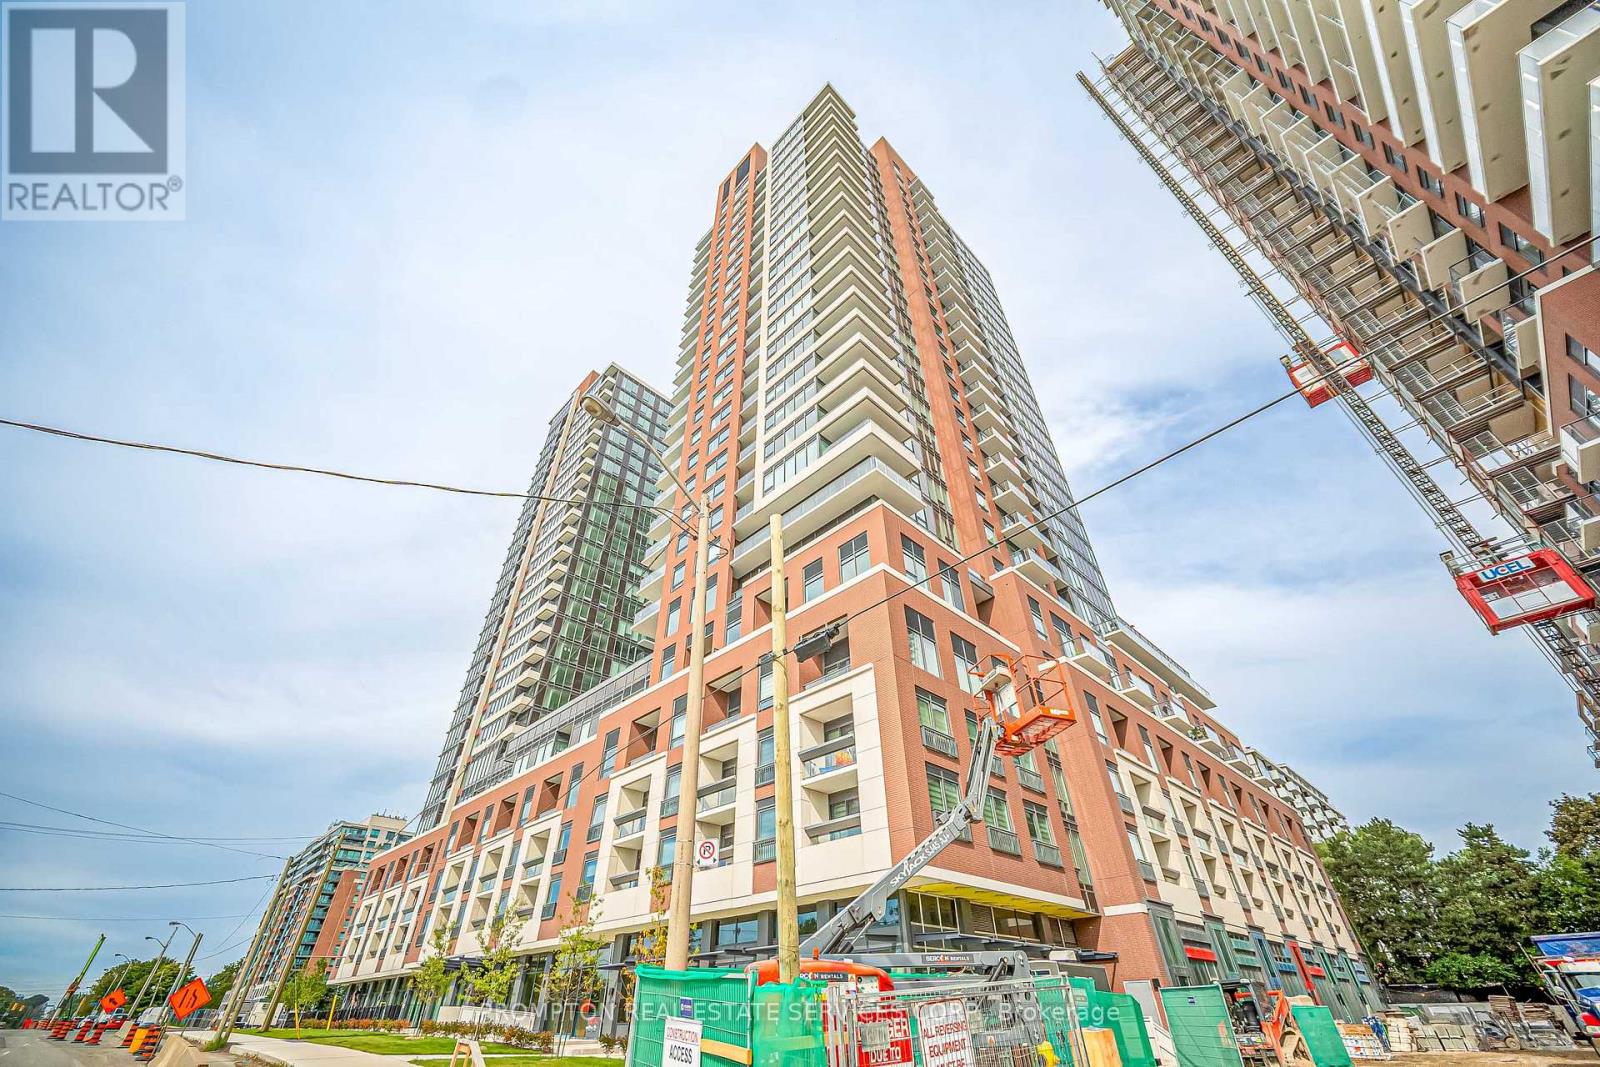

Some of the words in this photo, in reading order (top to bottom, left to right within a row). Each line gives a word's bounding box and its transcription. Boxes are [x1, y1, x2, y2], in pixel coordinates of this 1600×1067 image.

[1480, 560, 1531, 580] UCEL
[889, 854, 928, 888] SKYJACK
[666, 1026, 699, 1043] CONSTRUCTION
[923, 1027, 935, 1038] ALL
[935, 1020, 967, 1037] REVERSING
[669, 1044, 692, 1065] ACCESS
[870, 1049, 889, 1063] DUE
[889, 1047, 901, 1060] TO
[928, 1038, 966, 1058] EQUIPMENT
